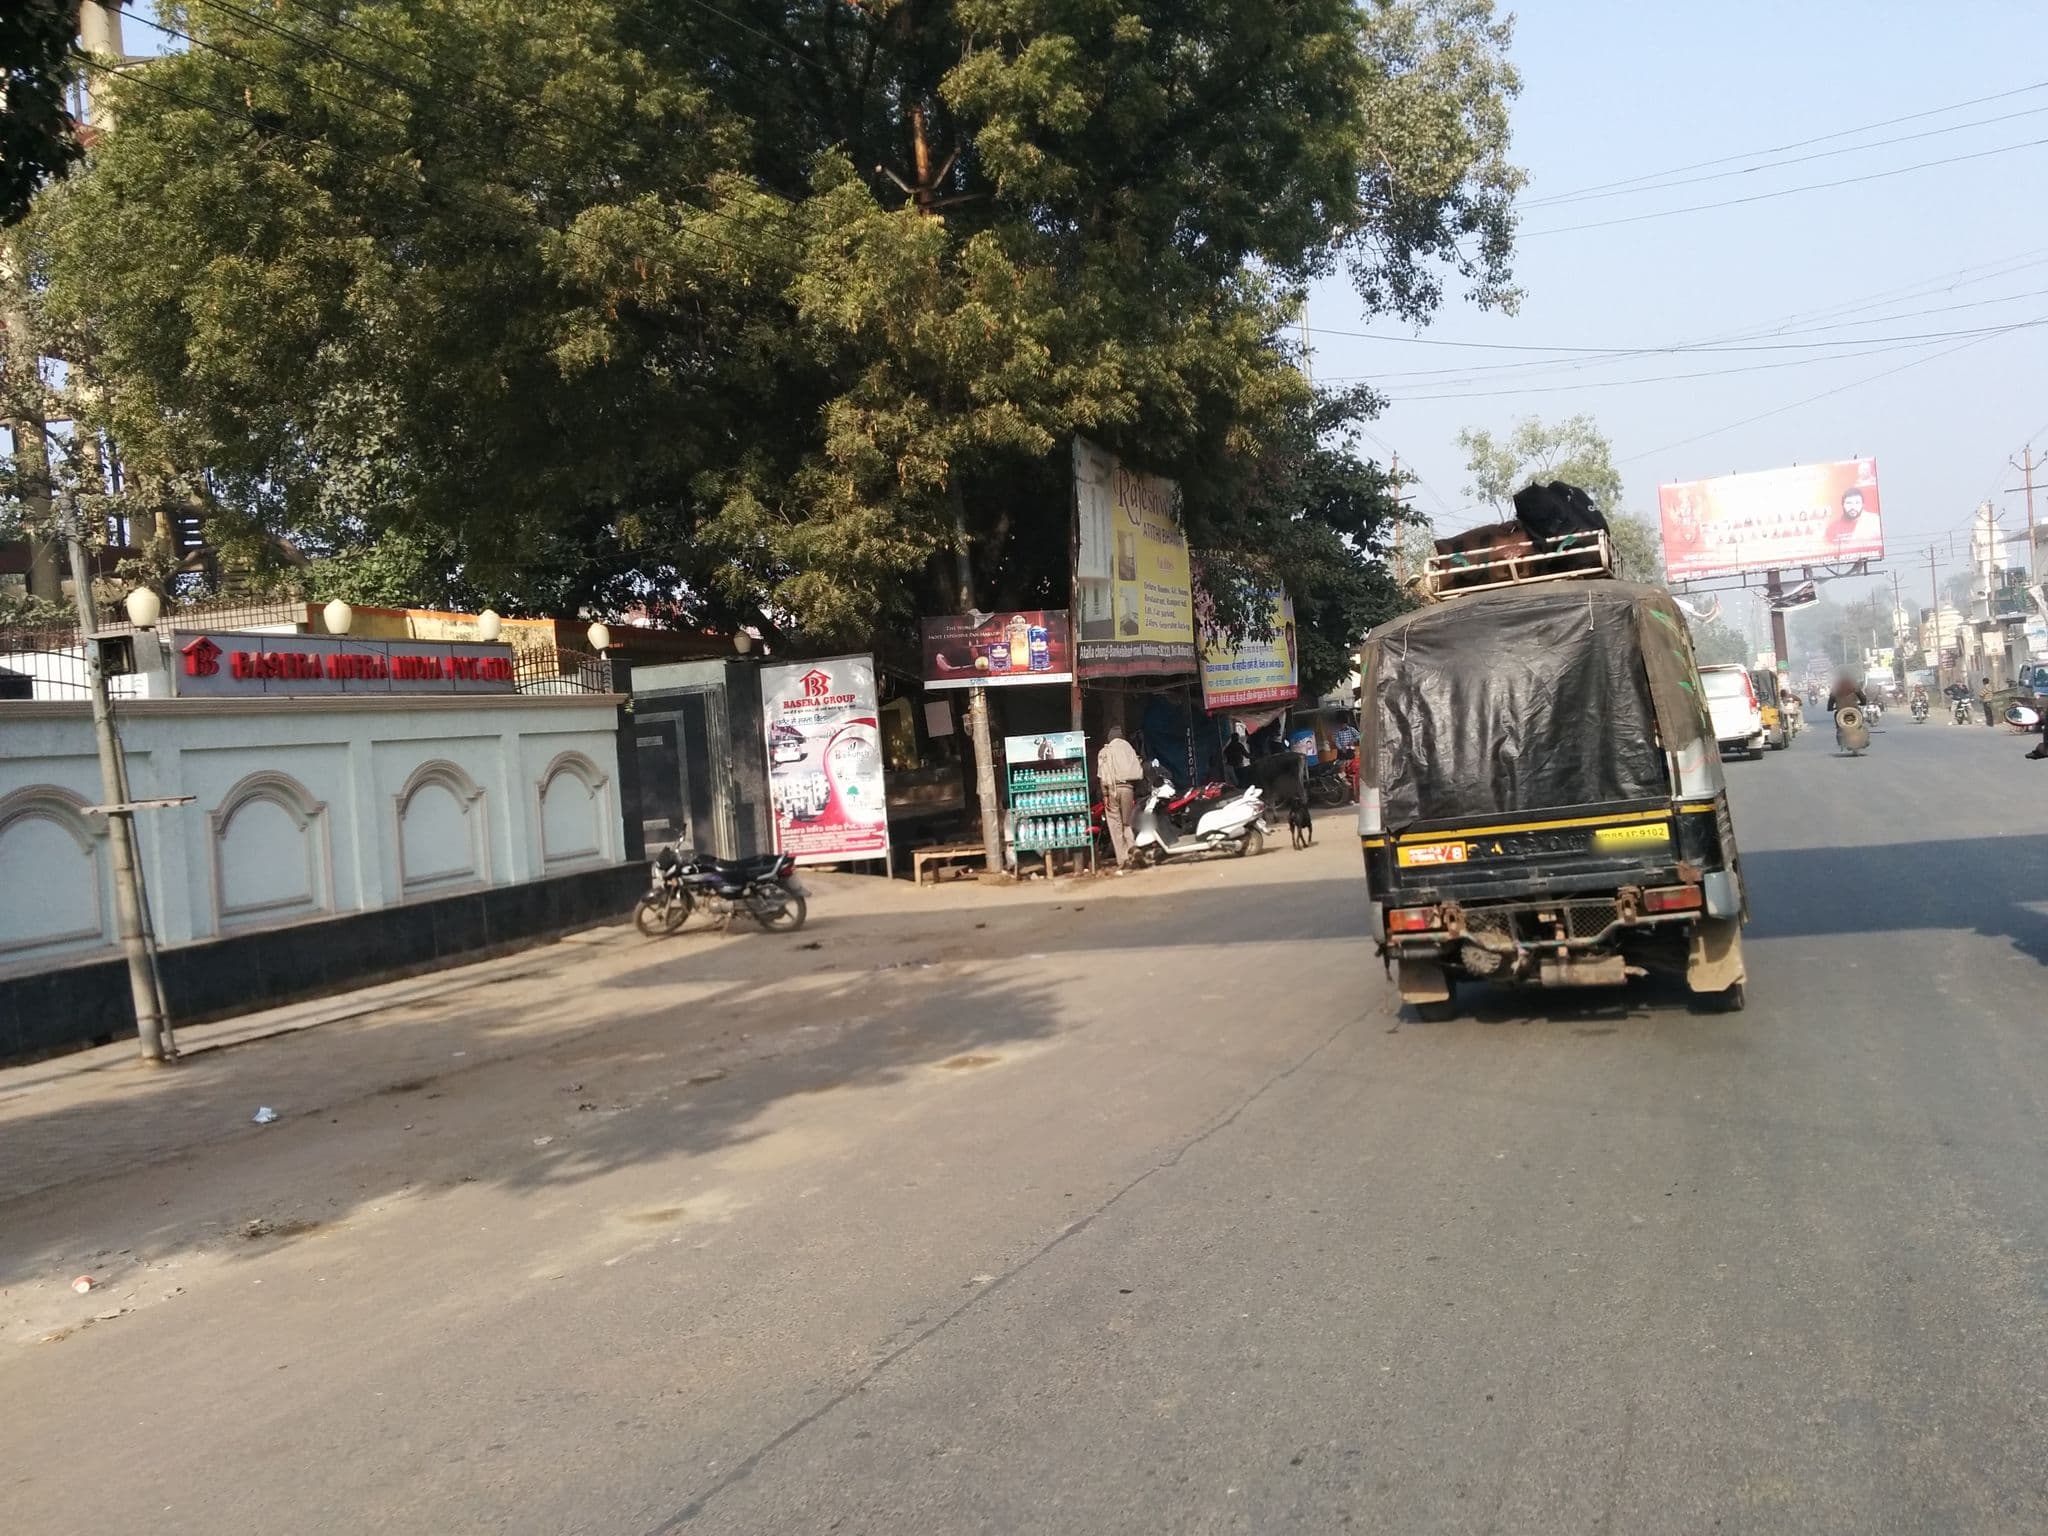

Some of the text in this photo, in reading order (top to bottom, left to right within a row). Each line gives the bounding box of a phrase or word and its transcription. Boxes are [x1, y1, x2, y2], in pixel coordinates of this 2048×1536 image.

[1112, 466, 1174, 527] Rajeshw
[230, 651, 325, 680] BASERA
[326, 653, 389, 680] INFRA
[390, 655, 445, 680] INDIA
[783, 694, 856, 709] BASERA GROUP
